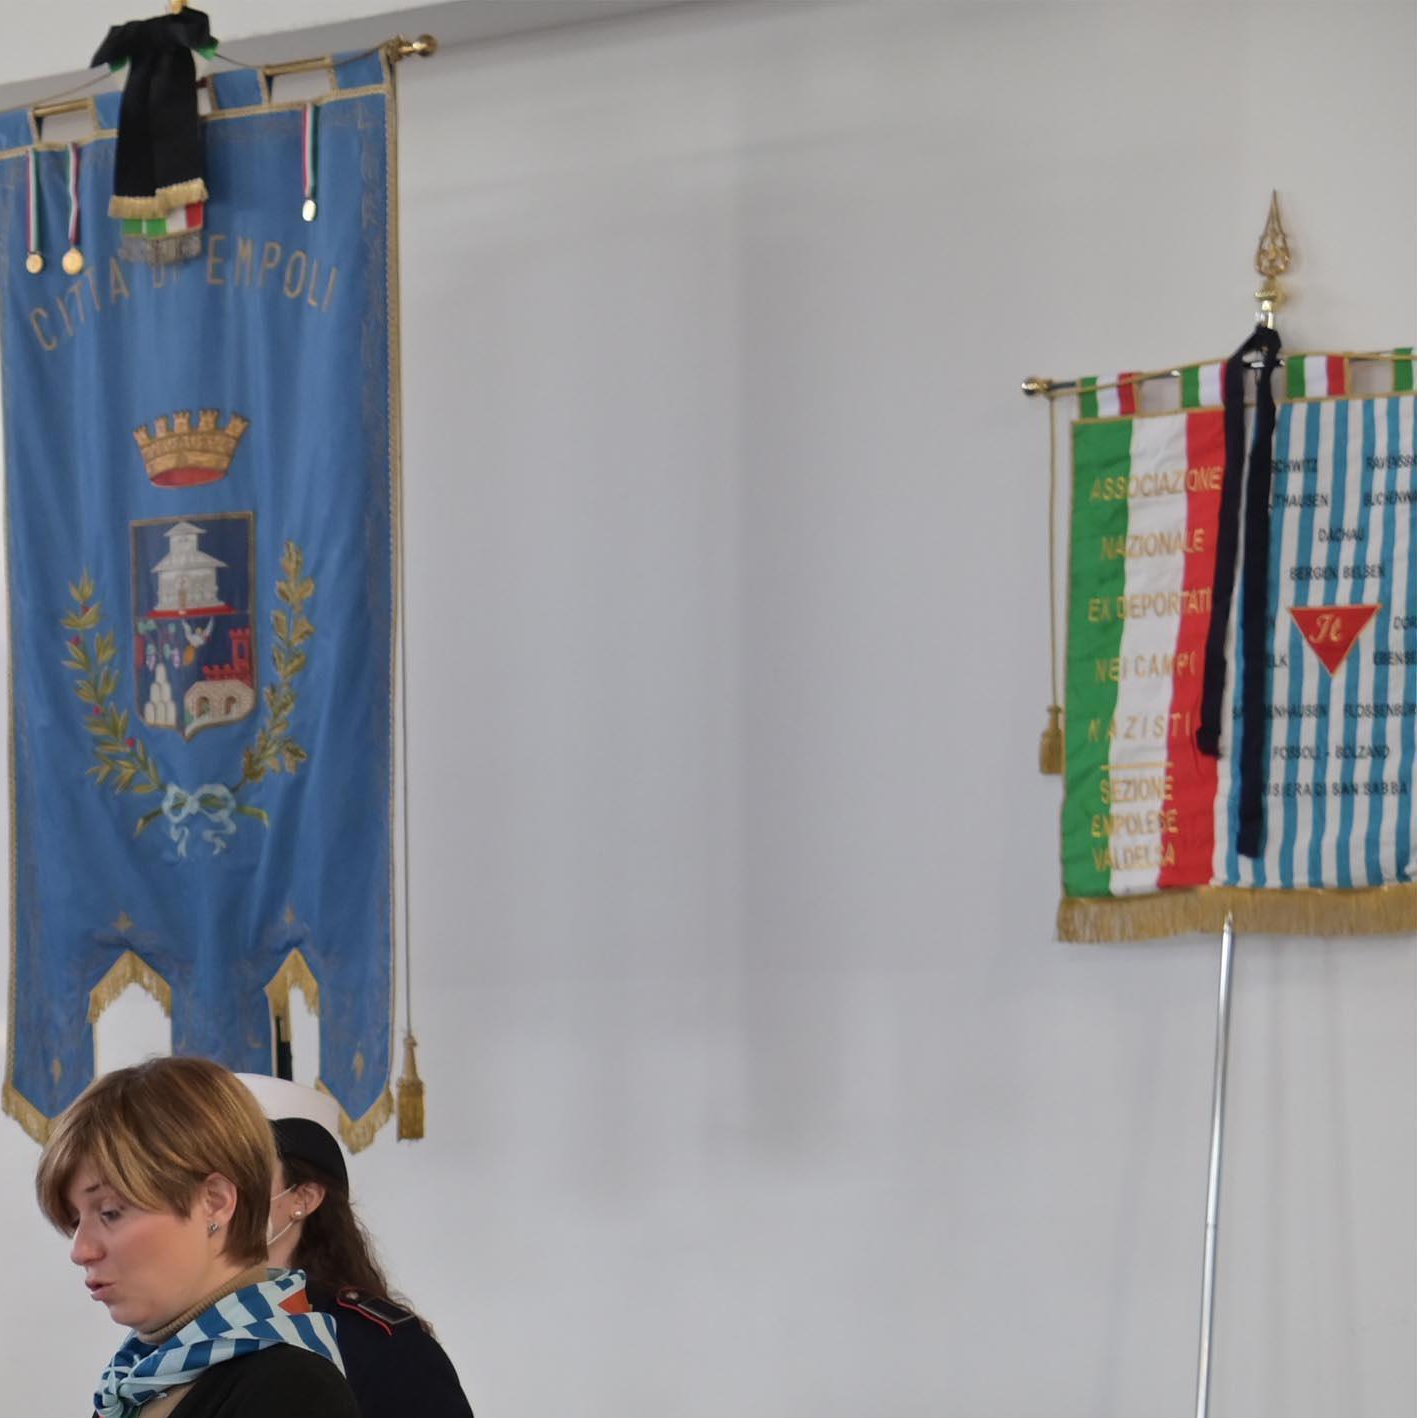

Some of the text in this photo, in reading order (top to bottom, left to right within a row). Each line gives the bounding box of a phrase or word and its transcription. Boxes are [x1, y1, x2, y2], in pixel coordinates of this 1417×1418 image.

[207, 235, 338, 313] EMPOLI
[1089, 466, 1224, 503] ASSOCIAZIONE
[1100, 528, 1206, 562] NAZIONALE
[1318, 527, 1365, 543] DACHAU
[1289, 564, 1386, 581] BERGEN BELSEN
[1087, 586, 1214, 624] EX DEPORTATI
[1095, 650, 1199, 683] NEI CAMPI
[1088, 710, 1191, 745] NAZISTI
[1335, 744, 1390, 760] BOLZANO
[1100, 775, 1174, 805] SEZIONE
[1332, 782, 1358, 797] SAN
[1364, 781, 1408, 796] SABBA
[1092, 808, 1179, 839] EMPOLESE
[1093, 842, 1176, 873] VALDELSA
